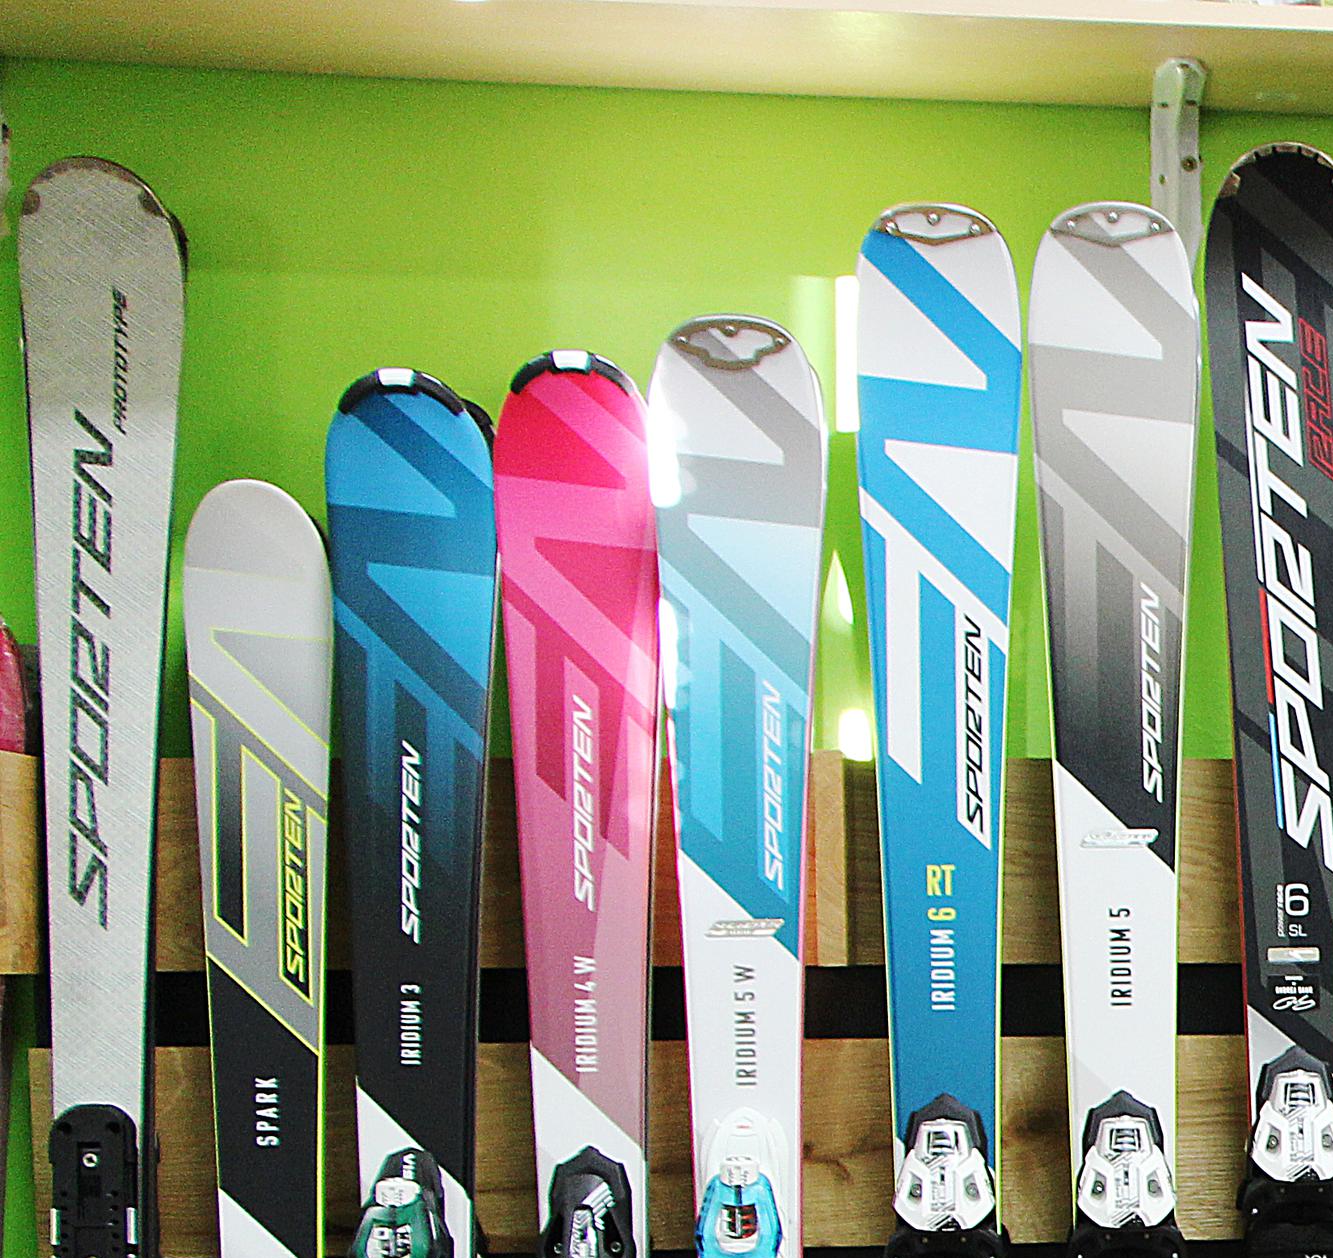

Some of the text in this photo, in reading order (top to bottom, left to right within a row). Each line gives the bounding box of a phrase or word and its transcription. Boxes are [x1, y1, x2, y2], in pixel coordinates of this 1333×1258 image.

[111, 286, 127, 436] PROTOTYPE
[69, 409, 118, 930] SPORTEN
[963, 613, 988, 835] SPORTEN
[1140, 582, 1163, 803] SPORTEN
[401, 740, 425, 944] SPORTEN
[572, 695, 596, 912] SPORTEN
[763, 680, 784, 891] SPORTEN
[284, 788, 305, 982] SPORTEN
[926, 865, 955, 896] RT
[1284, 884, 1309, 916] 6
[1288, 923, 1307, 937] SL
[574, 955, 598, 1073] IRIDIUM 4 W
[928, 907, 956, 1011] IRIDIUM 6
[1111, 907, 1132, 1006] IRIDIUM 5
[401, 984, 422, 1065] IRIDIUM 3
[733, 964, 758, 1086] IRIDIUM 5 W
[256, 1076, 279, 1148] SPARK
